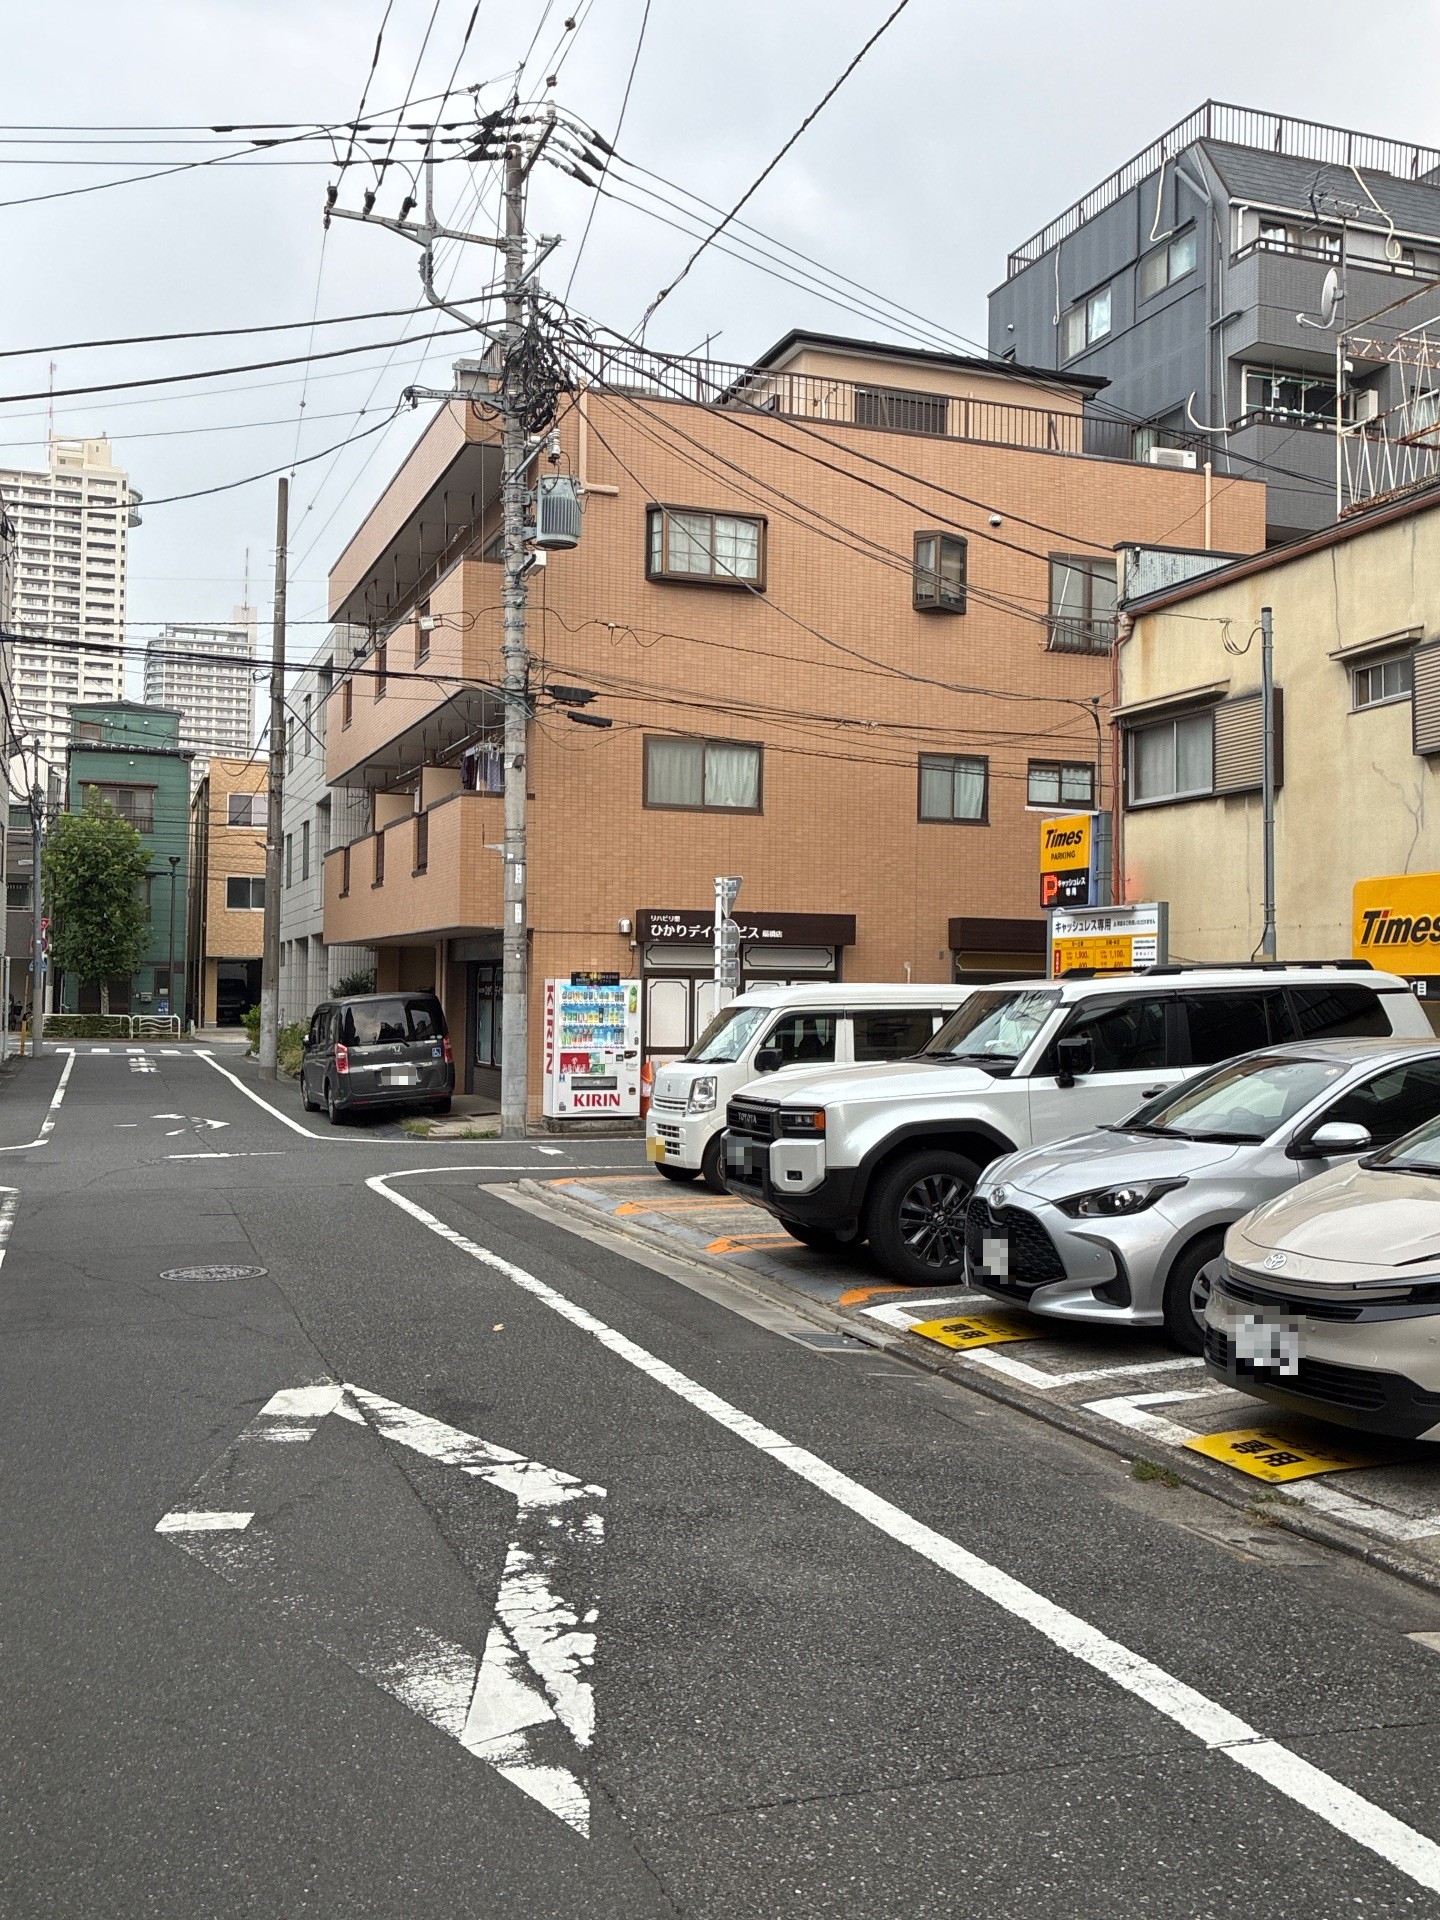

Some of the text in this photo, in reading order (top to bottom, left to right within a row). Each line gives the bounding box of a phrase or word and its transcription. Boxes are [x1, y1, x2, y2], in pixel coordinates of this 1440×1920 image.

[1045, 828, 1083, 848] Times
[1051, 850, 1076, 860] PARKING
[1058, 877, 1086, 887] キャッシュレス
[1043, 875, 1057, 905] P
[1055, 919, 1111, 933] キャッシュレス専用
[546, 985, 554, 1075] KIRIN
[573, 1093, 621, 1107] KIRIN
[738, 1112, 757, 1124] TOYOTA
[1230, 1439, 1306, 1467] 専用
